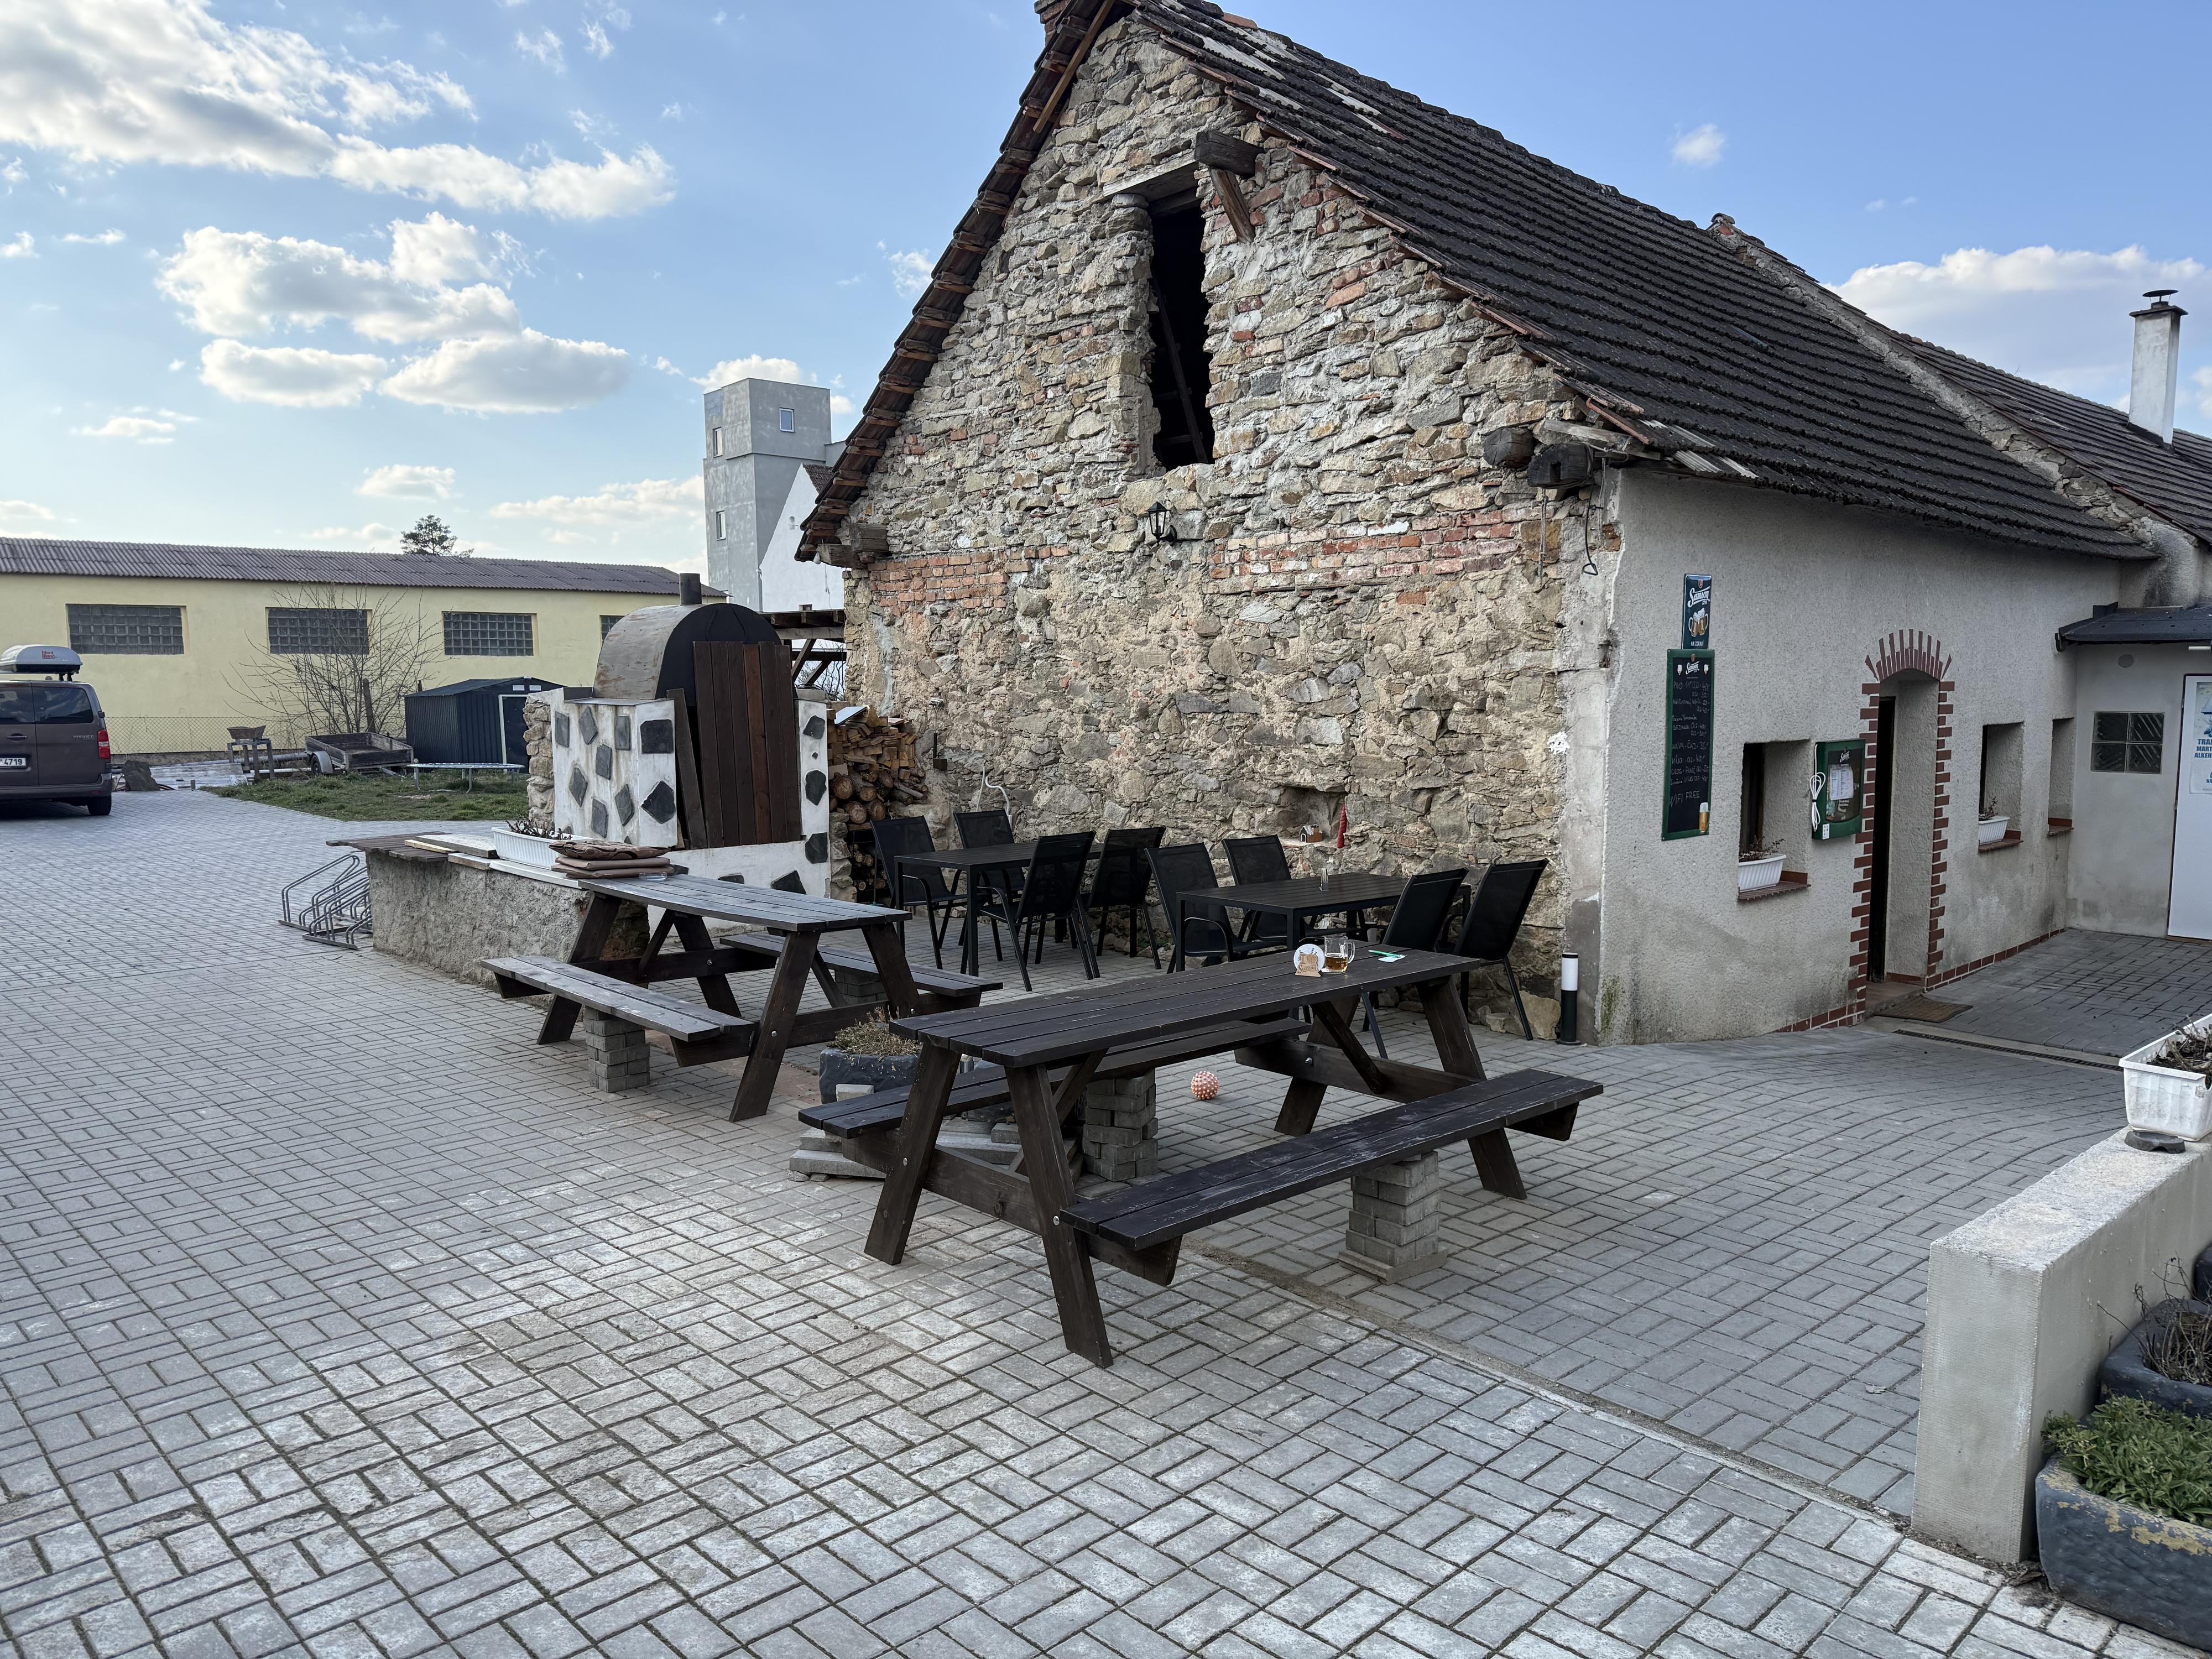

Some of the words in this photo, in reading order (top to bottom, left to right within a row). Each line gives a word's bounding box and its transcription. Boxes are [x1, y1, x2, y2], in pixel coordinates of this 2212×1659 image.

[1687, 586, 1710, 608] Samson
[1686, 661, 1699, 675] Samson
[1686, 790, 1700, 800] FREE
[1297, 964, 1317, 973] Samson
